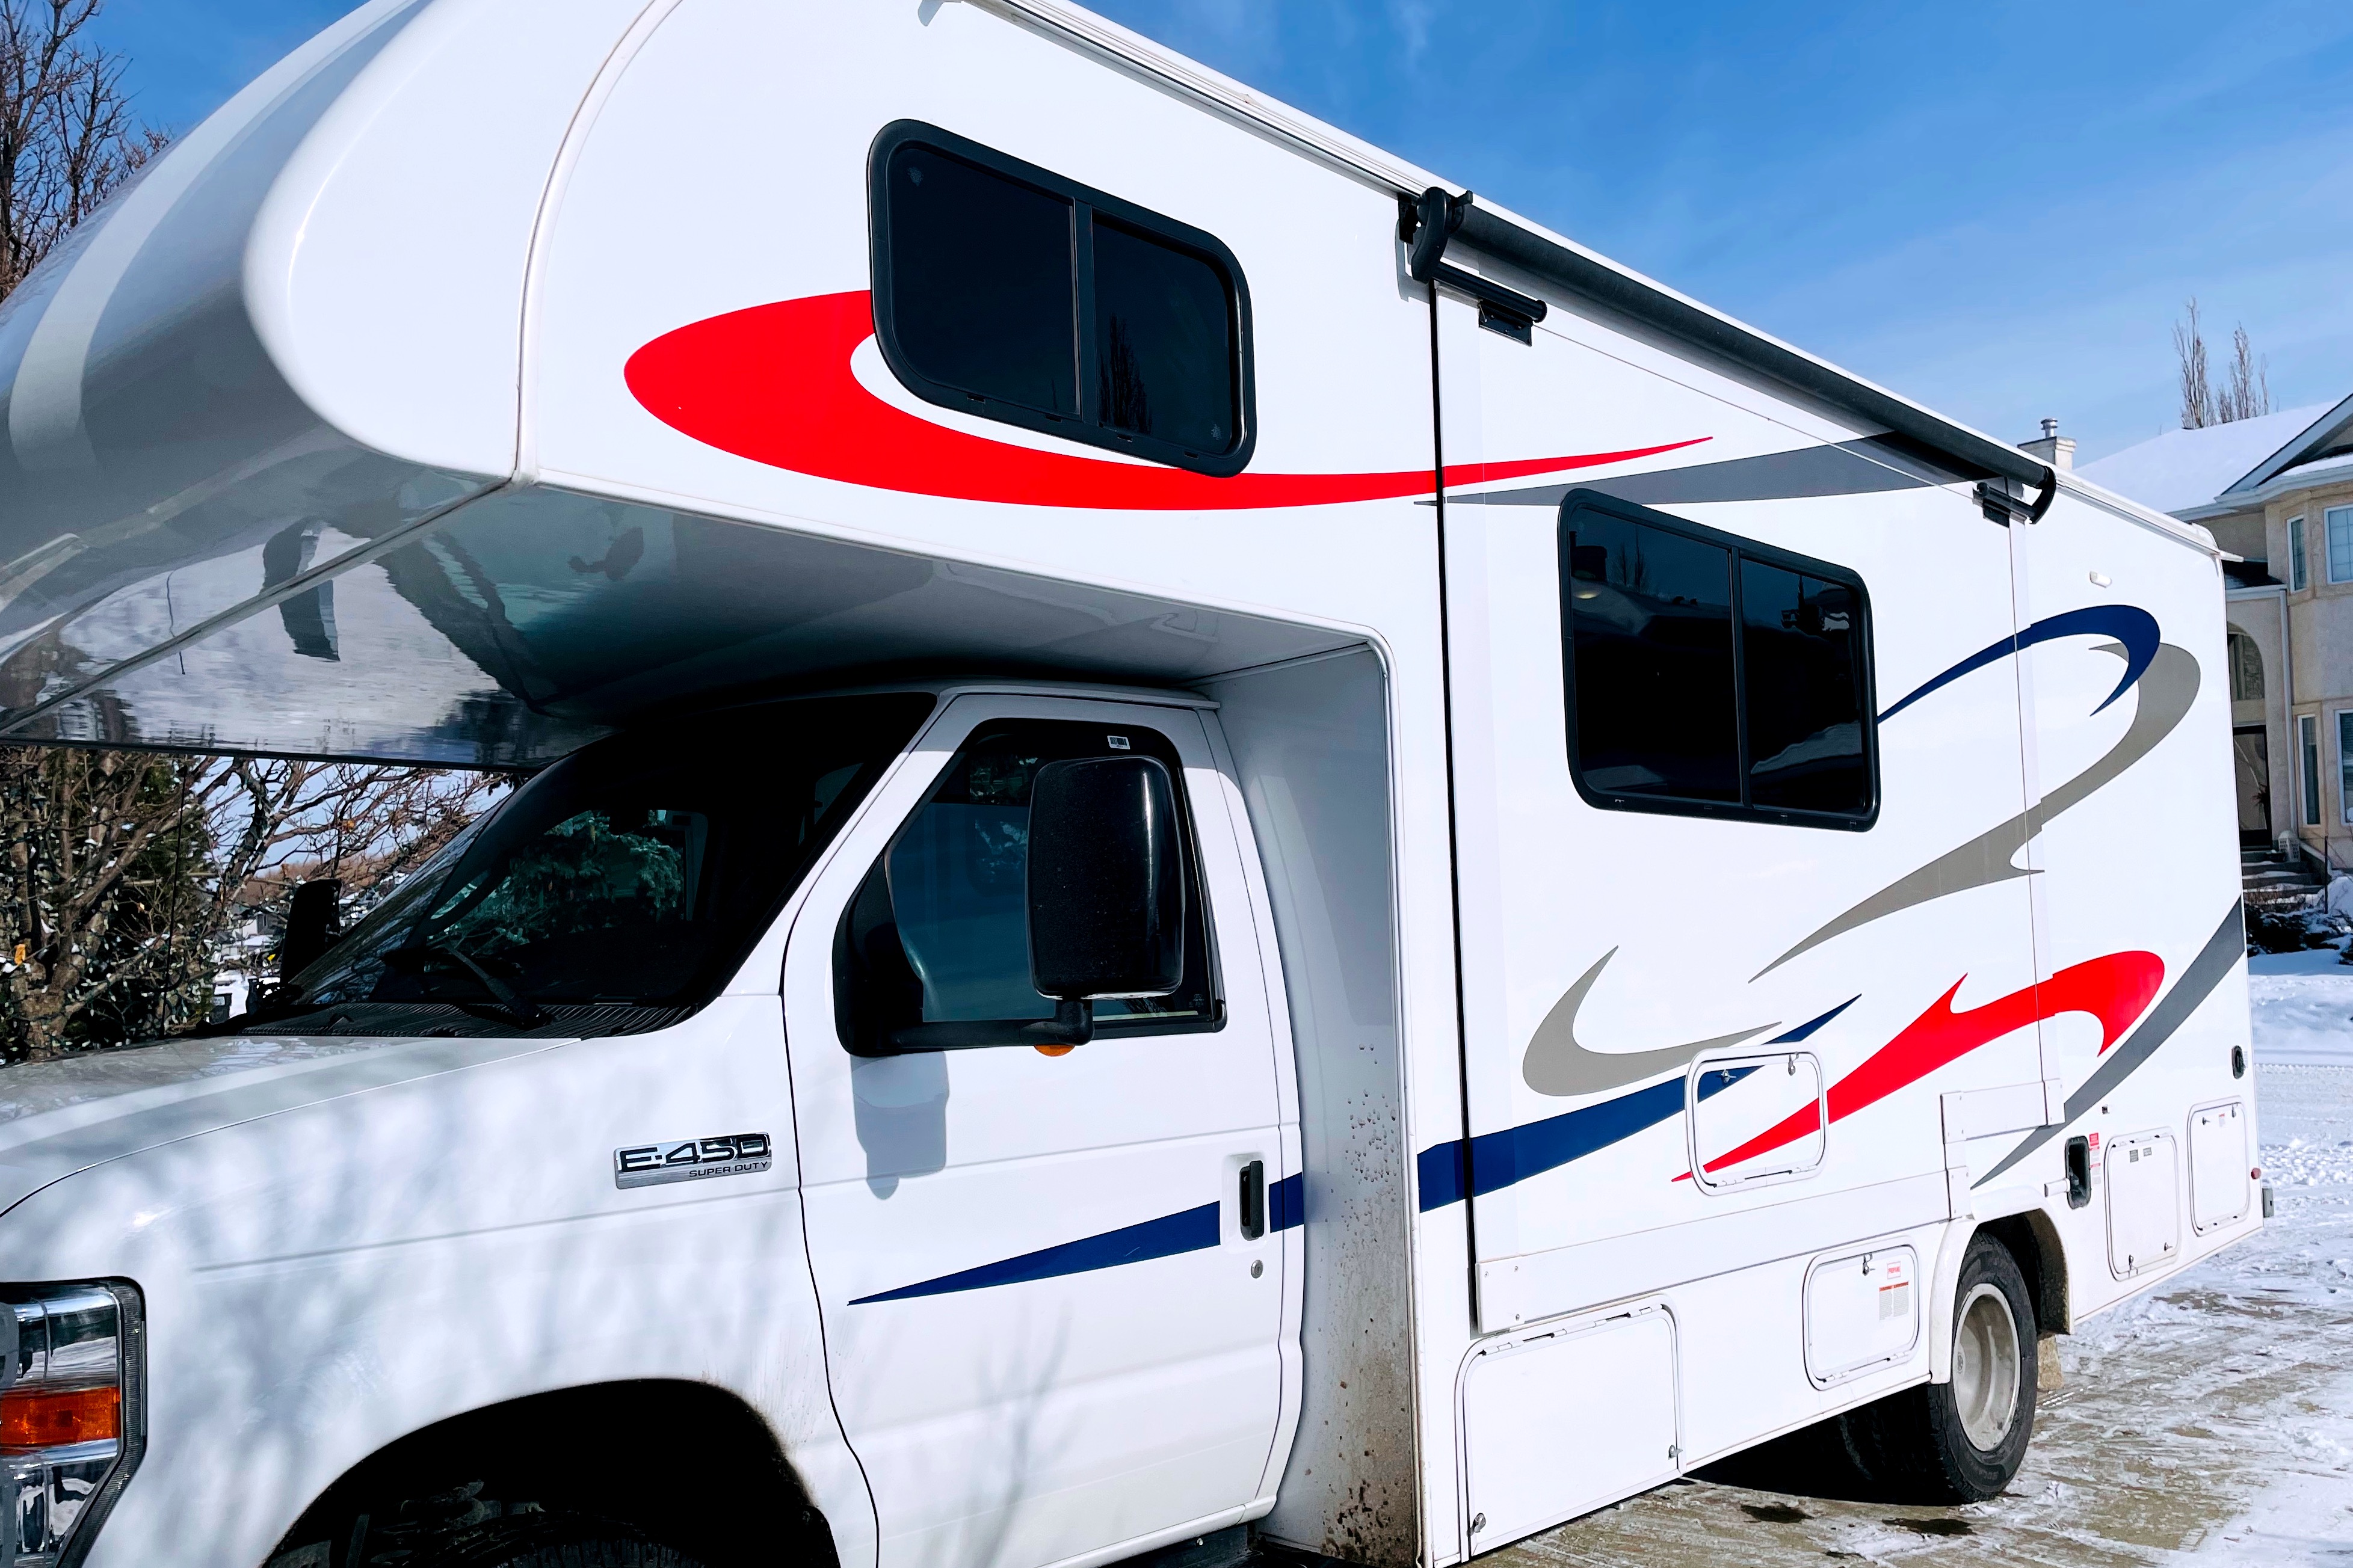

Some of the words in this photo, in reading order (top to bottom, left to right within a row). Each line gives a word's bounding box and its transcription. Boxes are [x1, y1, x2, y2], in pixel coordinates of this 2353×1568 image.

[618, 1133, 771, 1173] E-450
[689, 1166, 731, 1178] SUPER
[735, 1161, 768, 1172] DUTY
